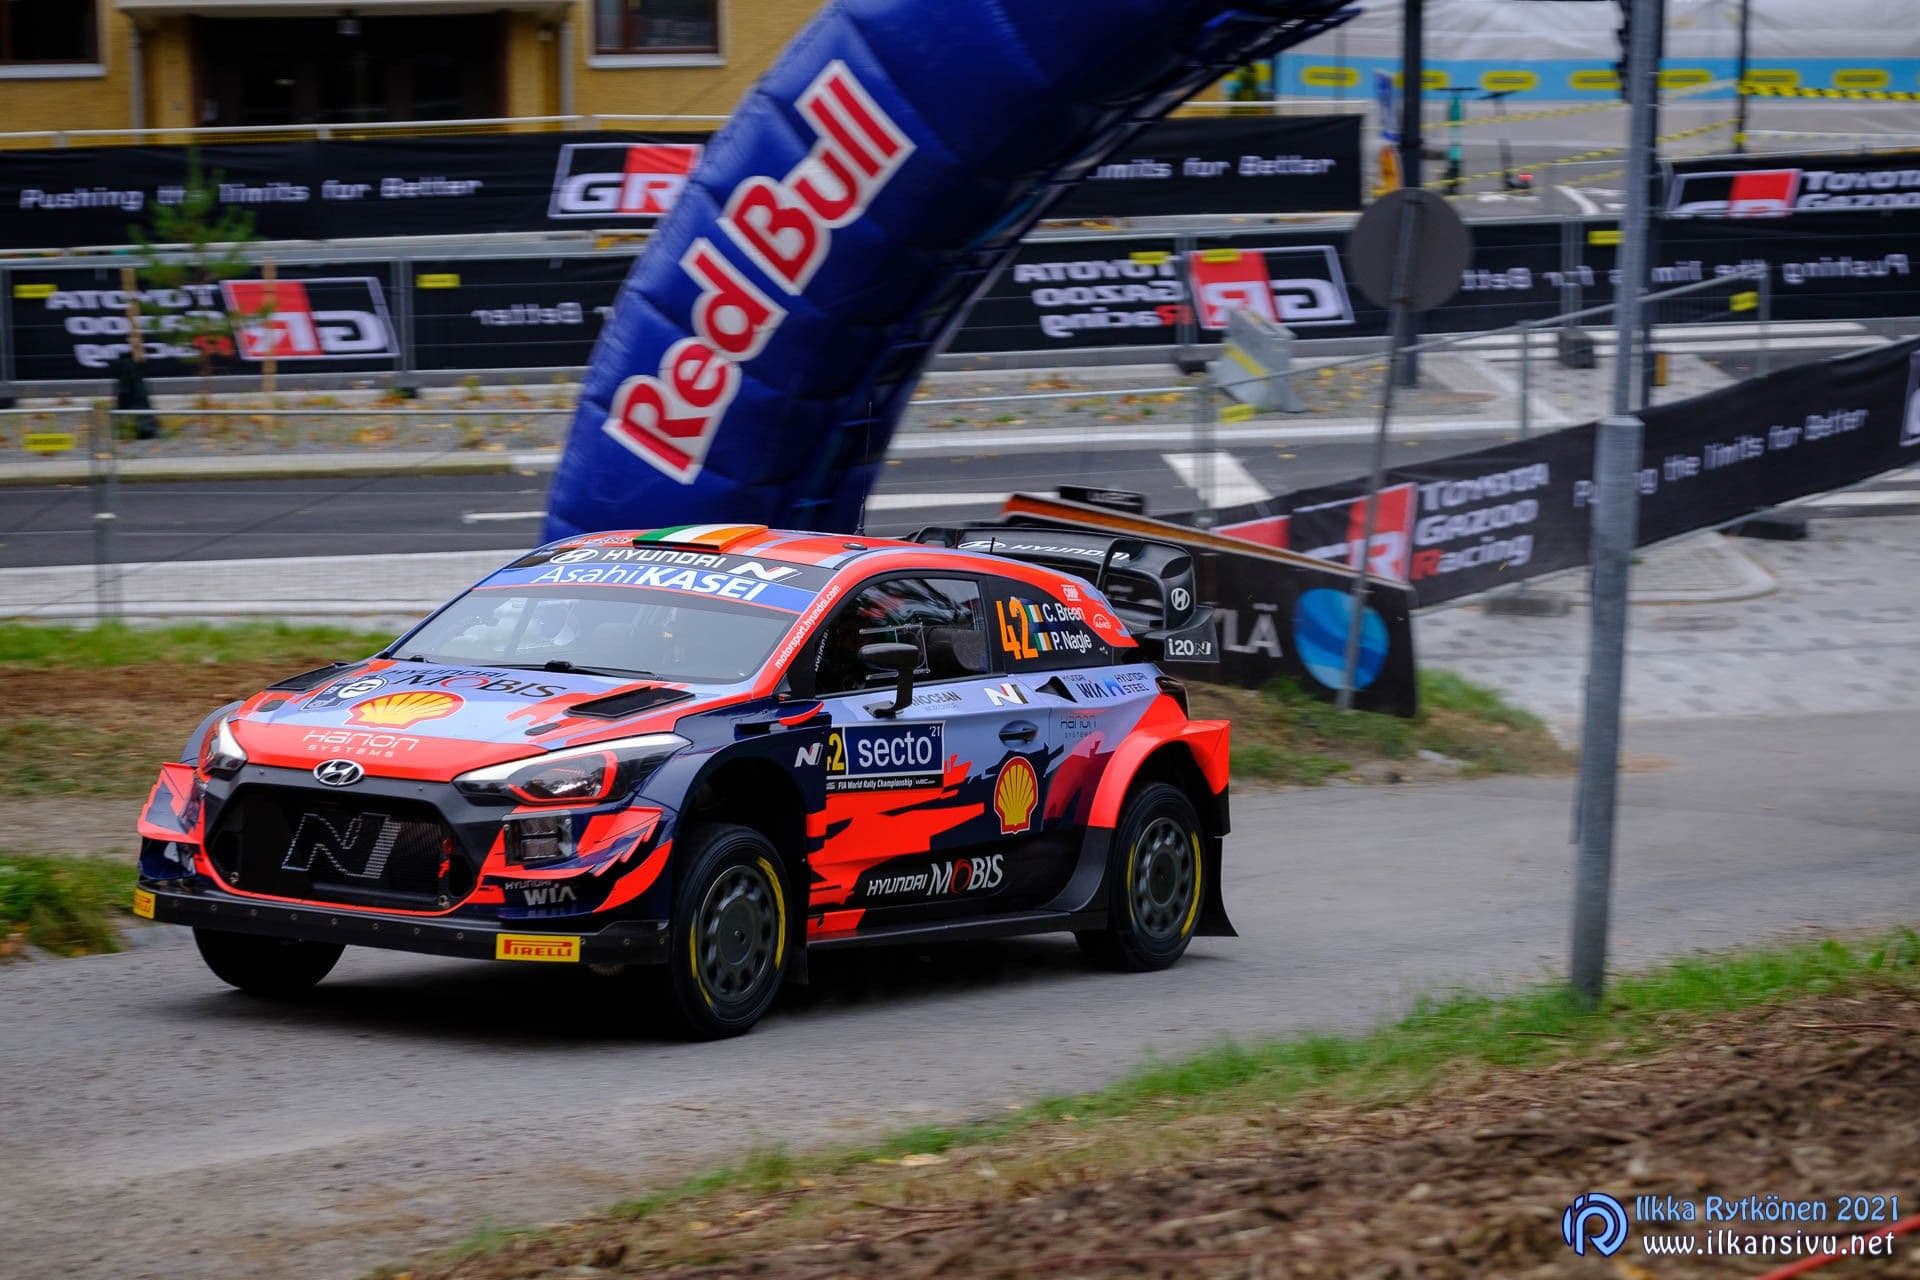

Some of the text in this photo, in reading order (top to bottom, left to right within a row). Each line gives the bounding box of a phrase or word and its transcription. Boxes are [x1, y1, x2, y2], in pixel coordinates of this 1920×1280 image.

[1182, 157, 1231, 178] for
[1238, 155, 1337, 176] Better
[19, 187, 145, 211] Pushing
[218, 182, 311, 203] limits
[321, 179, 372, 199] for
[380, 176, 484, 198] Better
[556, 172, 690, 213] GR
[602, 59, 917, 485] Red Bull
[1768, 425, 1802, 450] for
[1805, 409, 1869, 441] Better
[1419, 462, 1550, 511] TOYOTA
[1413, 499, 1540, 547] GAZOO
[602, 549, 727, 569] HYUNDAI
[1411, 535, 1536, 581] Racing
[774, 584, 841, 670] motorsport.hyundai.com
[996, 596, 1039, 660] 42
[1042, 603, 1058, 623] C.
[1054, 602, 1087, 622] Breen
[1050, 629, 1093, 654] P. Nagle
[390, 674, 568, 698] MOBIS
[1121, 682, 1150, 695] STEEL
[857, 730, 933, 768] secto
[837, 781, 848, 790] FIA
[863, 779, 877, 791] Rally
[877, 777, 914, 789] Championship
[867, 853, 1005, 898] HYUNDAI MOBIS
[503, 938, 574, 958] PIRELLI
